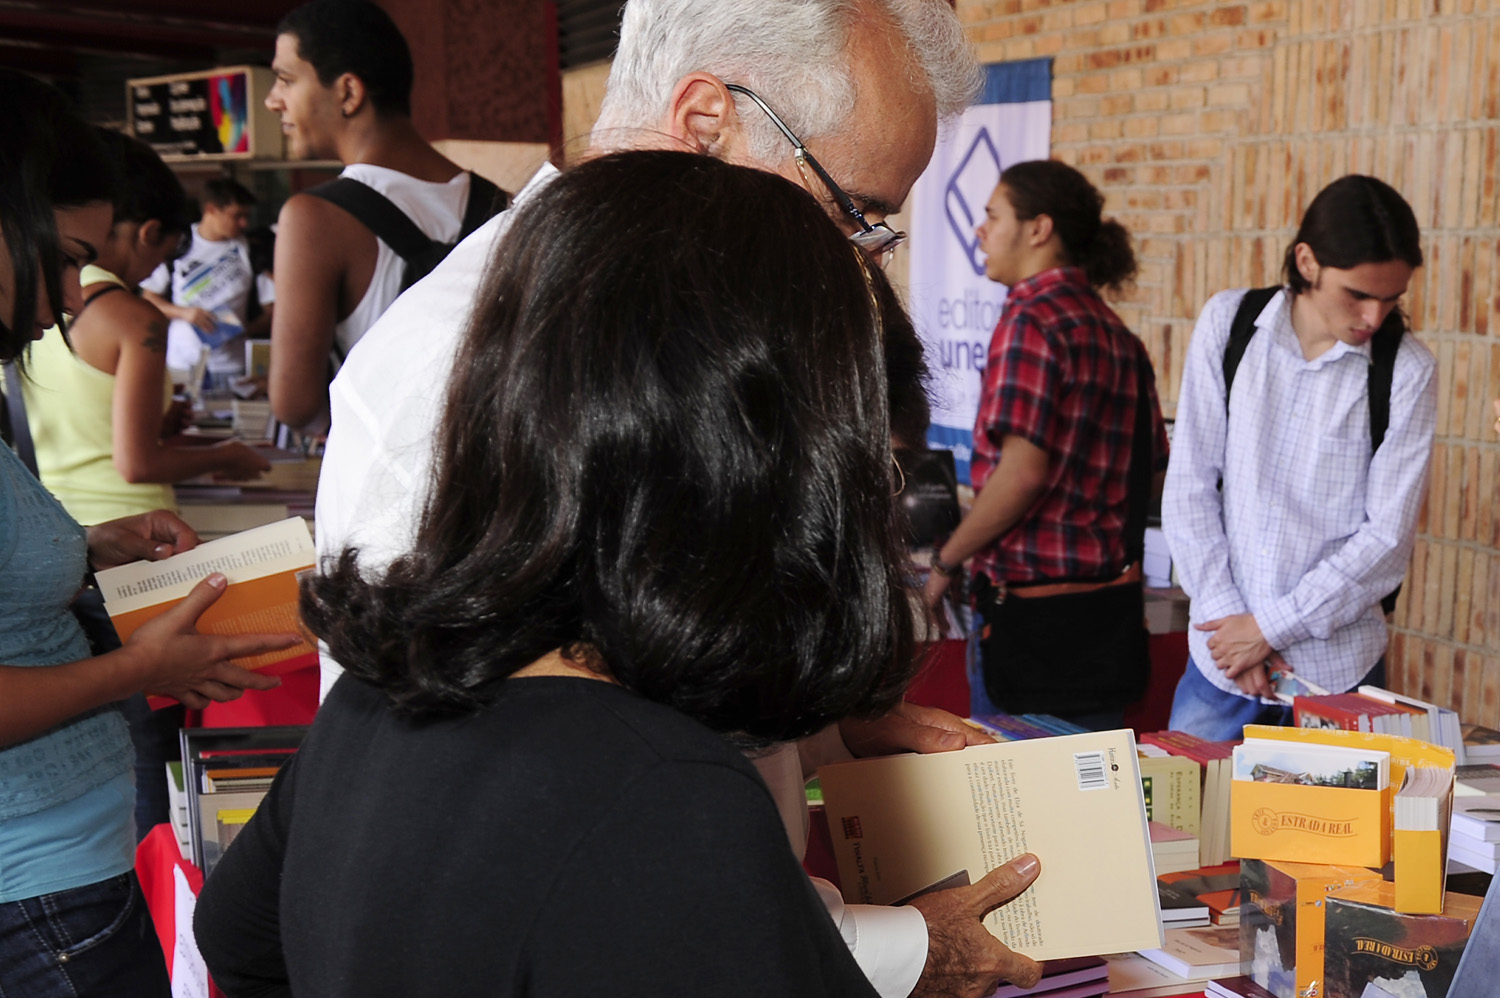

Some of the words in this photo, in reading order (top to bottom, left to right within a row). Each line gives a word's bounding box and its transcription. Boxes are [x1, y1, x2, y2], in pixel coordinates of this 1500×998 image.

[940, 339, 984, 373] une
[1280, 815, 1326, 832] ESTRADA
[1328, 821, 1352, 835] REAL
[1354, 938, 1375, 952] REAL
[1375, 943, 1414, 962] ESTRADA
